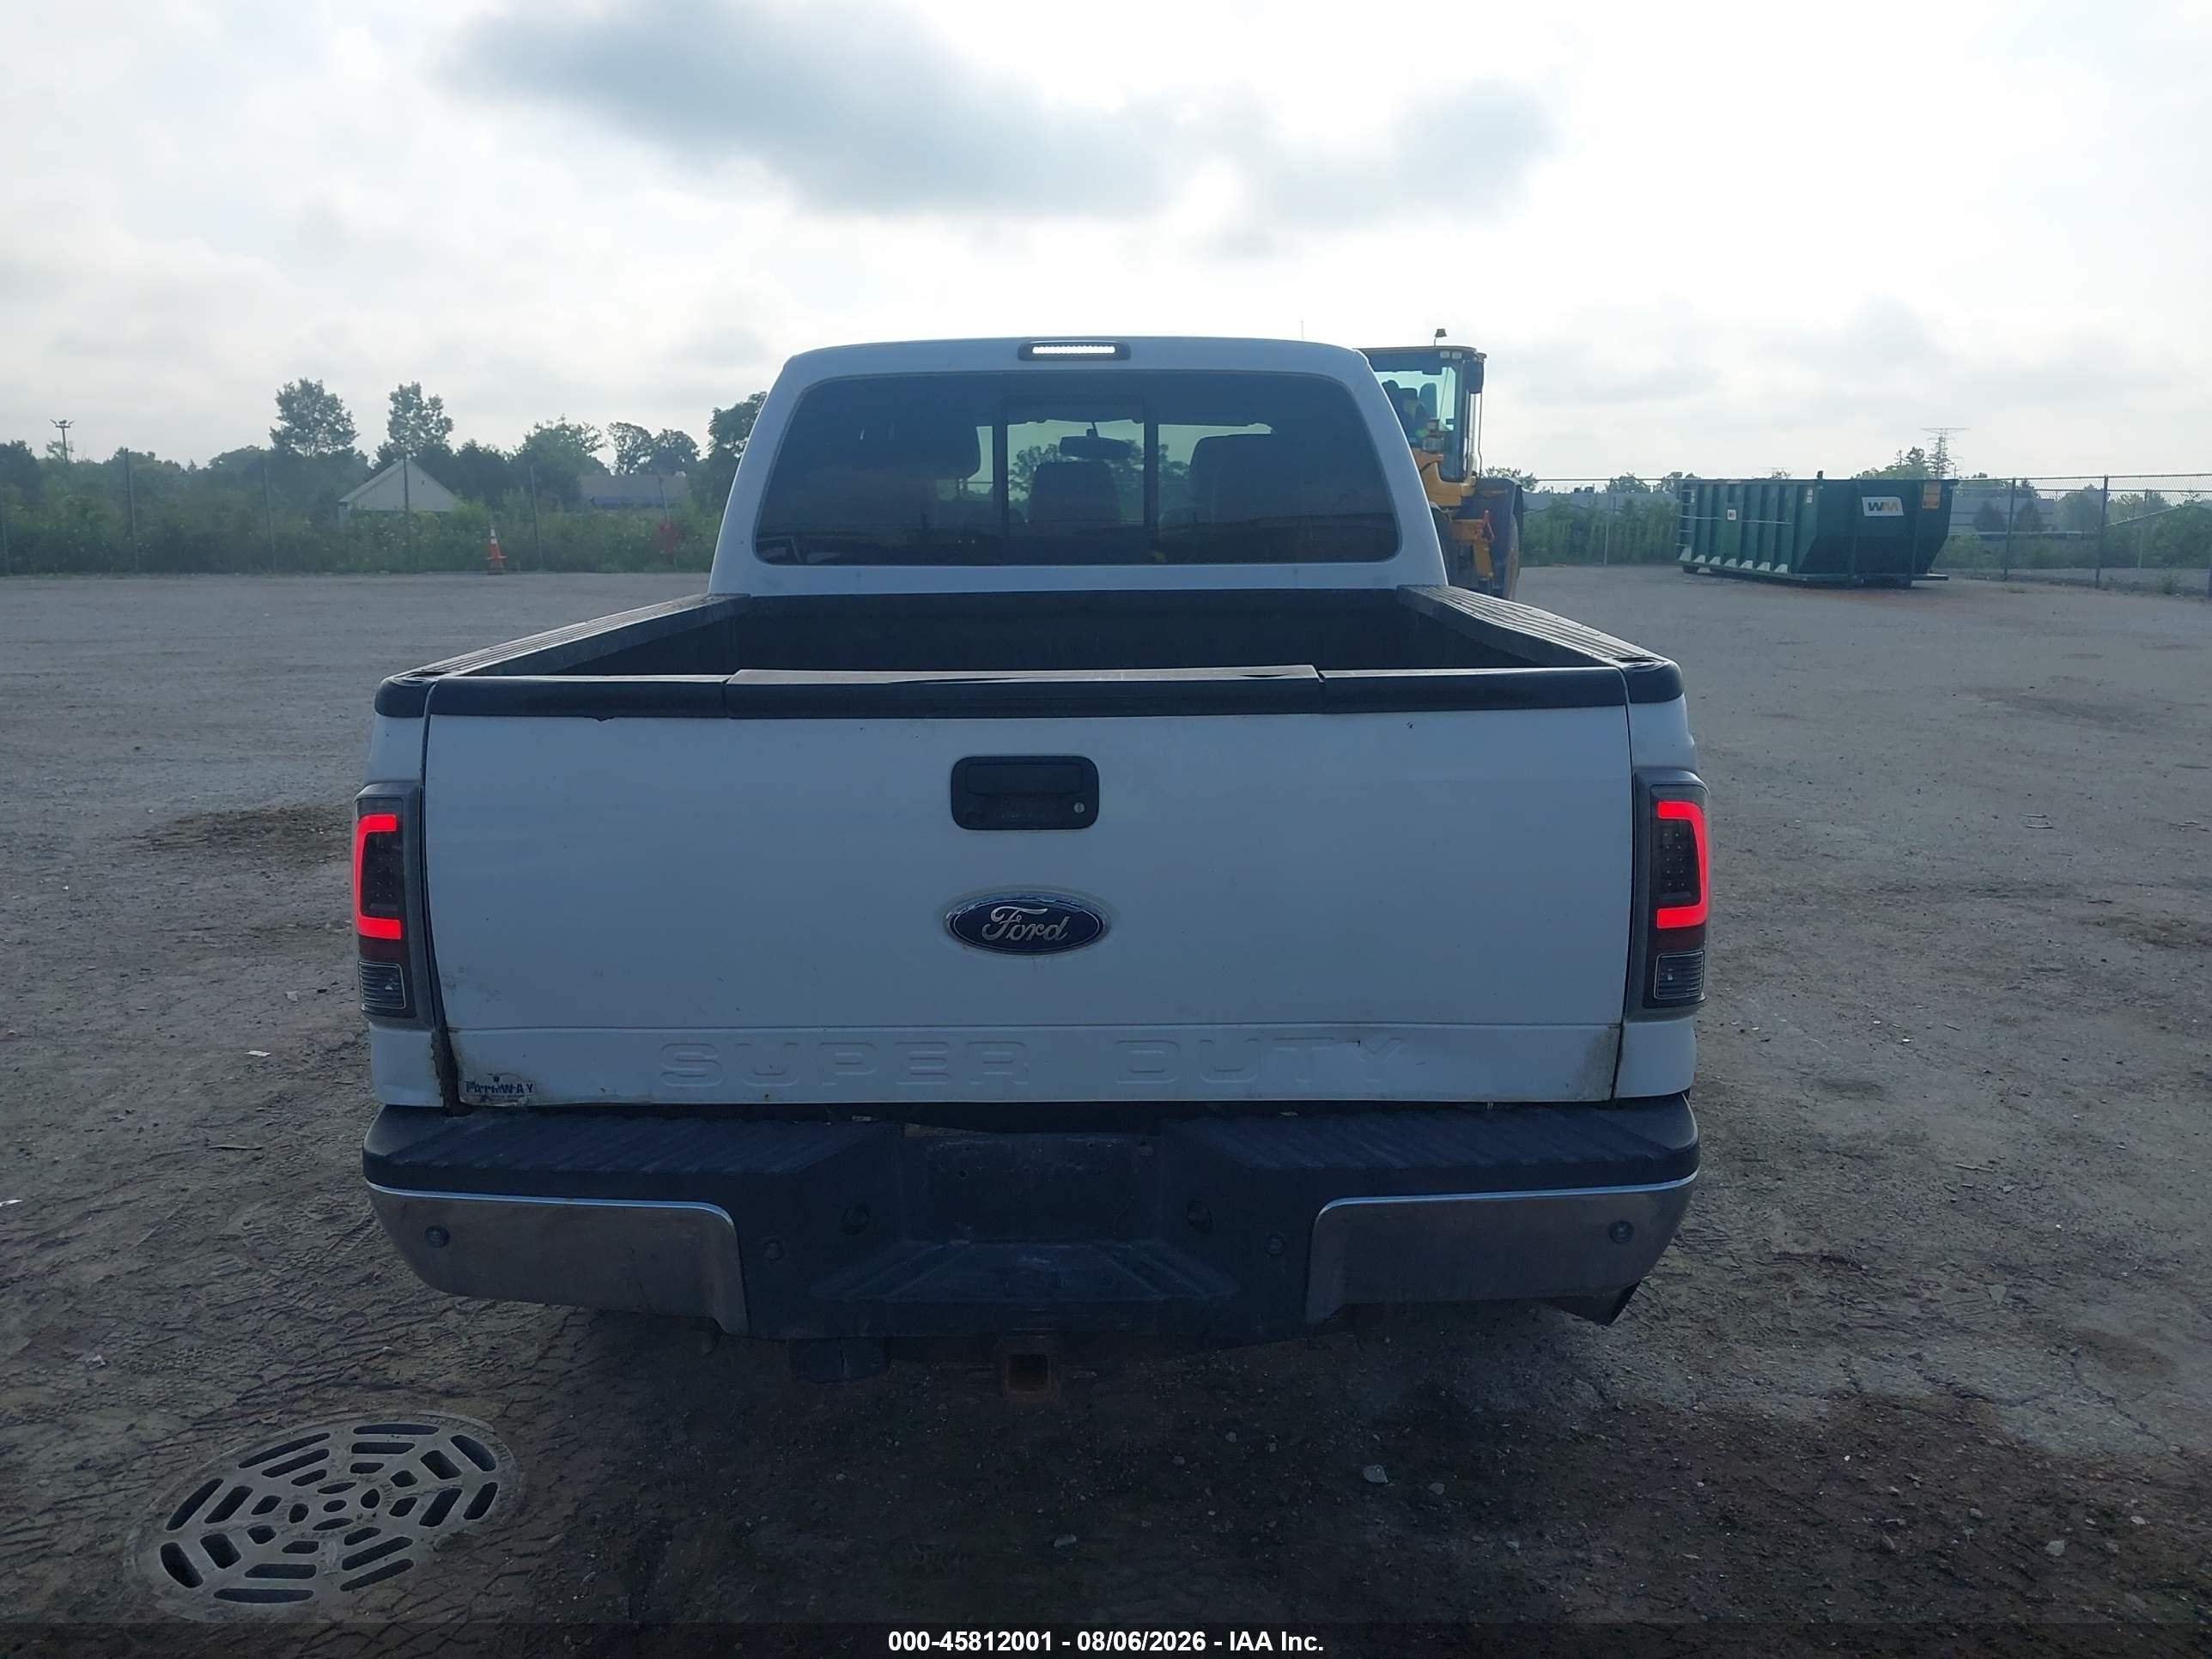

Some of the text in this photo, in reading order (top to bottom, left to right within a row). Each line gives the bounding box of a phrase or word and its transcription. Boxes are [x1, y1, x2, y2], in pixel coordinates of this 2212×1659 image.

[1868, 501, 1899, 513] WM
[981, 905, 1071, 941] Ford
[659, 1036, 1405, 1087] SUPER DUTY
